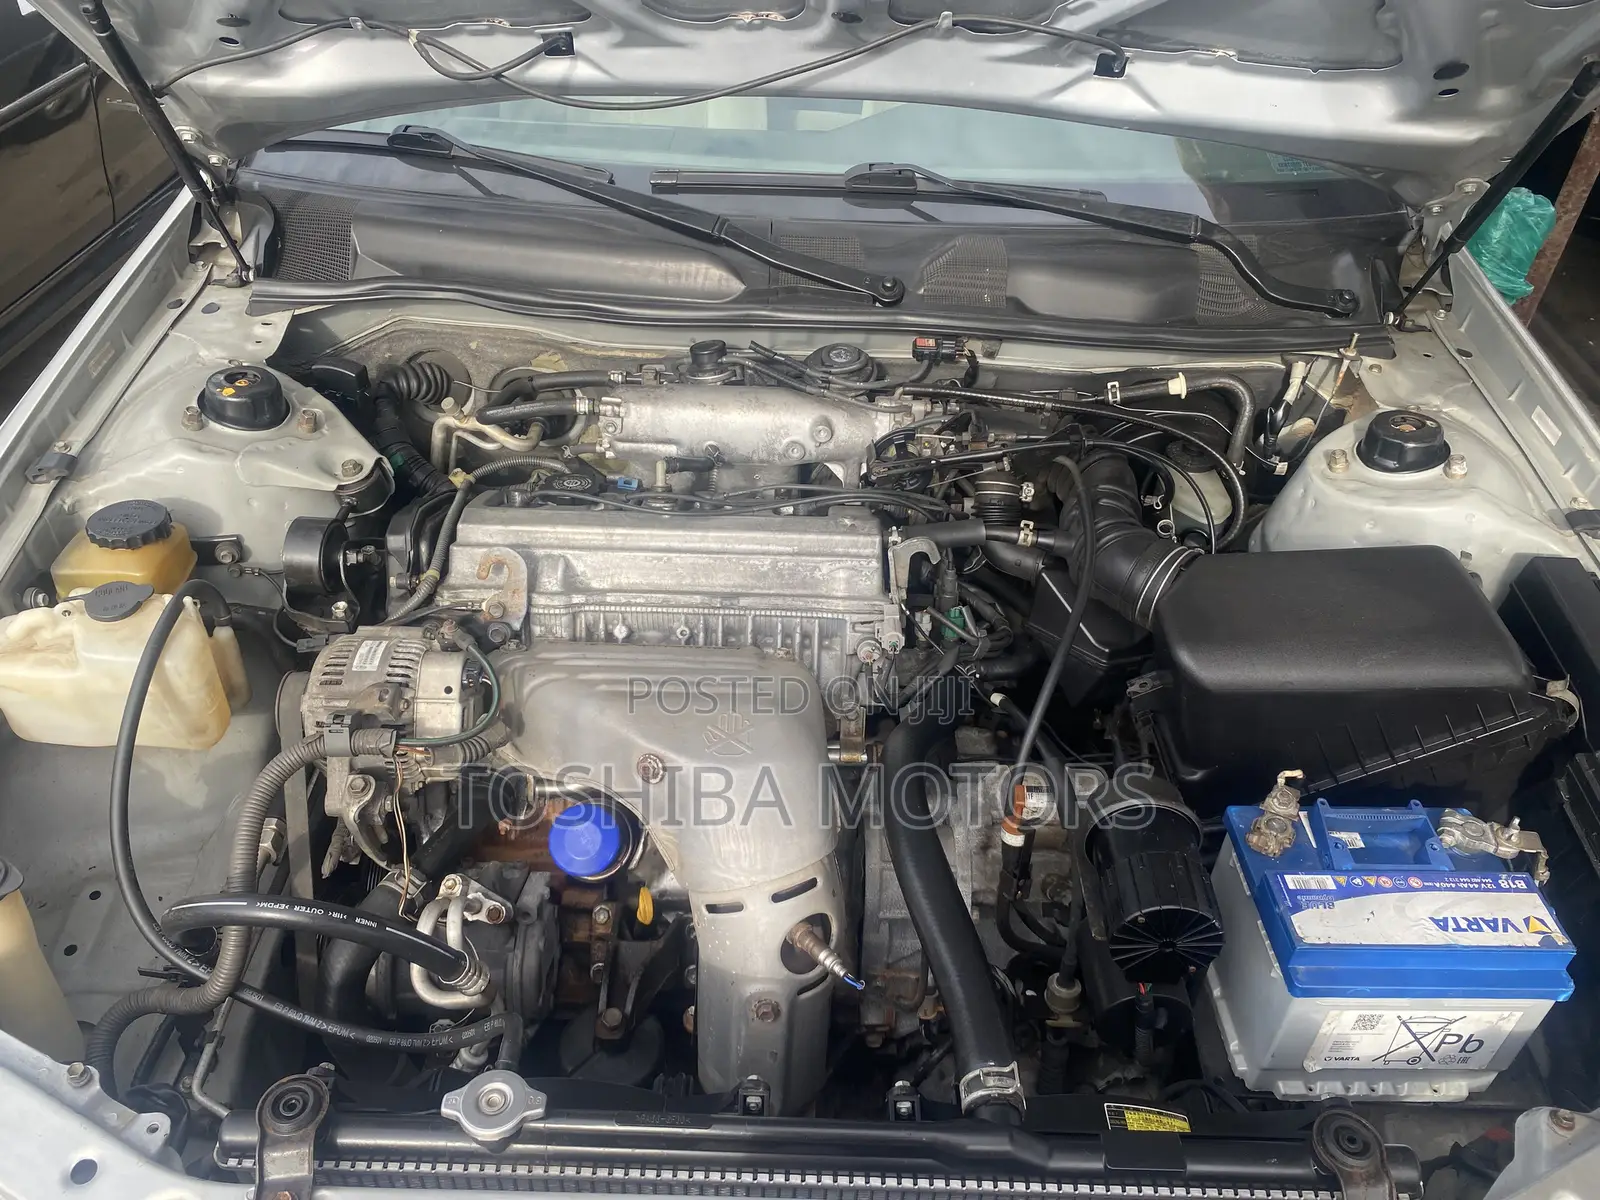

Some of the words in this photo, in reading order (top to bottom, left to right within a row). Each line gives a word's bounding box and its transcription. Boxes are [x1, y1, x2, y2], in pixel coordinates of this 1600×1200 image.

[1498, 879, 1528, 889] B18
[293, 905, 324, 915] OUTER
[1301, 901, 1335, 910] BLUE
[355, 917, 378, 928] INNER
[1428, 916, 1523, 933] VARTA
[1433, 1033, 1485, 1054] Pb
